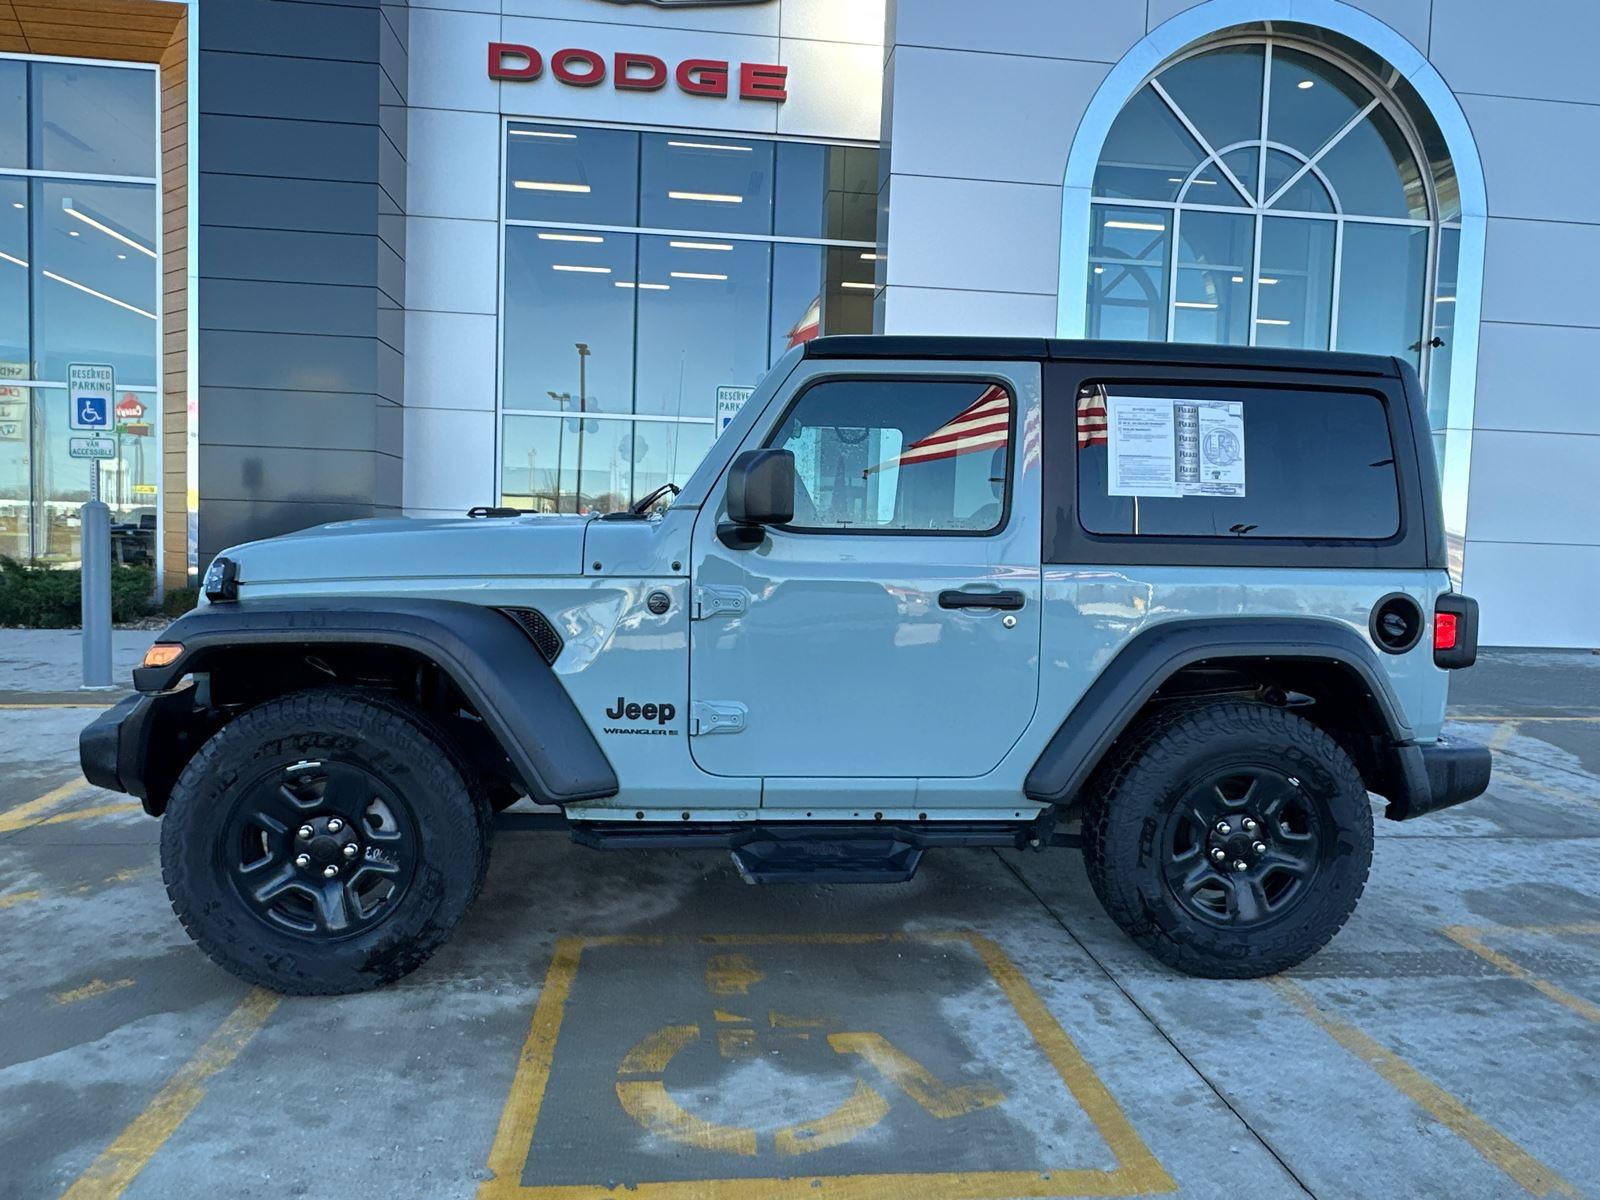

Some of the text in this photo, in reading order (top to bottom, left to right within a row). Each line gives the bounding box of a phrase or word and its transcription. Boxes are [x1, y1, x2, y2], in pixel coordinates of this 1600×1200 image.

[488, 42, 788, 103] DODGE
[71, 369, 111, 380] RESERVED
[71, 381, 111, 392] PARKING
[720, 391, 750, 401] RESERVE
[720, 402, 741, 411] PARK
[71, 448, 113, 456] ACCESSIBLE
[606, 696, 676, 725] Jeep
[603, 727, 667, 736] WRANGLER
